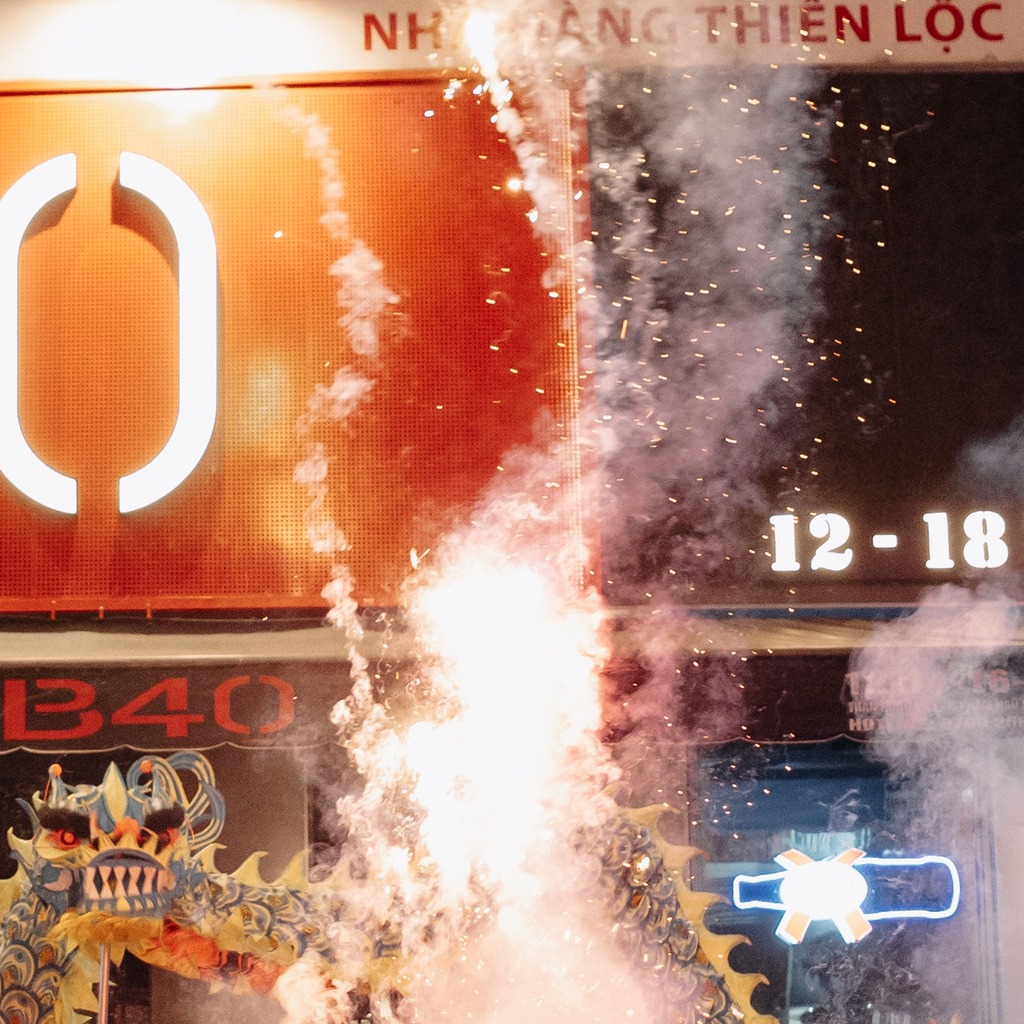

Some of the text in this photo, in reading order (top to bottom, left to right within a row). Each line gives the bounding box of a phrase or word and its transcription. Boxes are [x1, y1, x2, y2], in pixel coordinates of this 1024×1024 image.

[363, 12, 466, 51] NH
[770, 514, 854, 572] 12
[924, 510, 1010, 569] 18
[3, 675, 295, 741] B40
